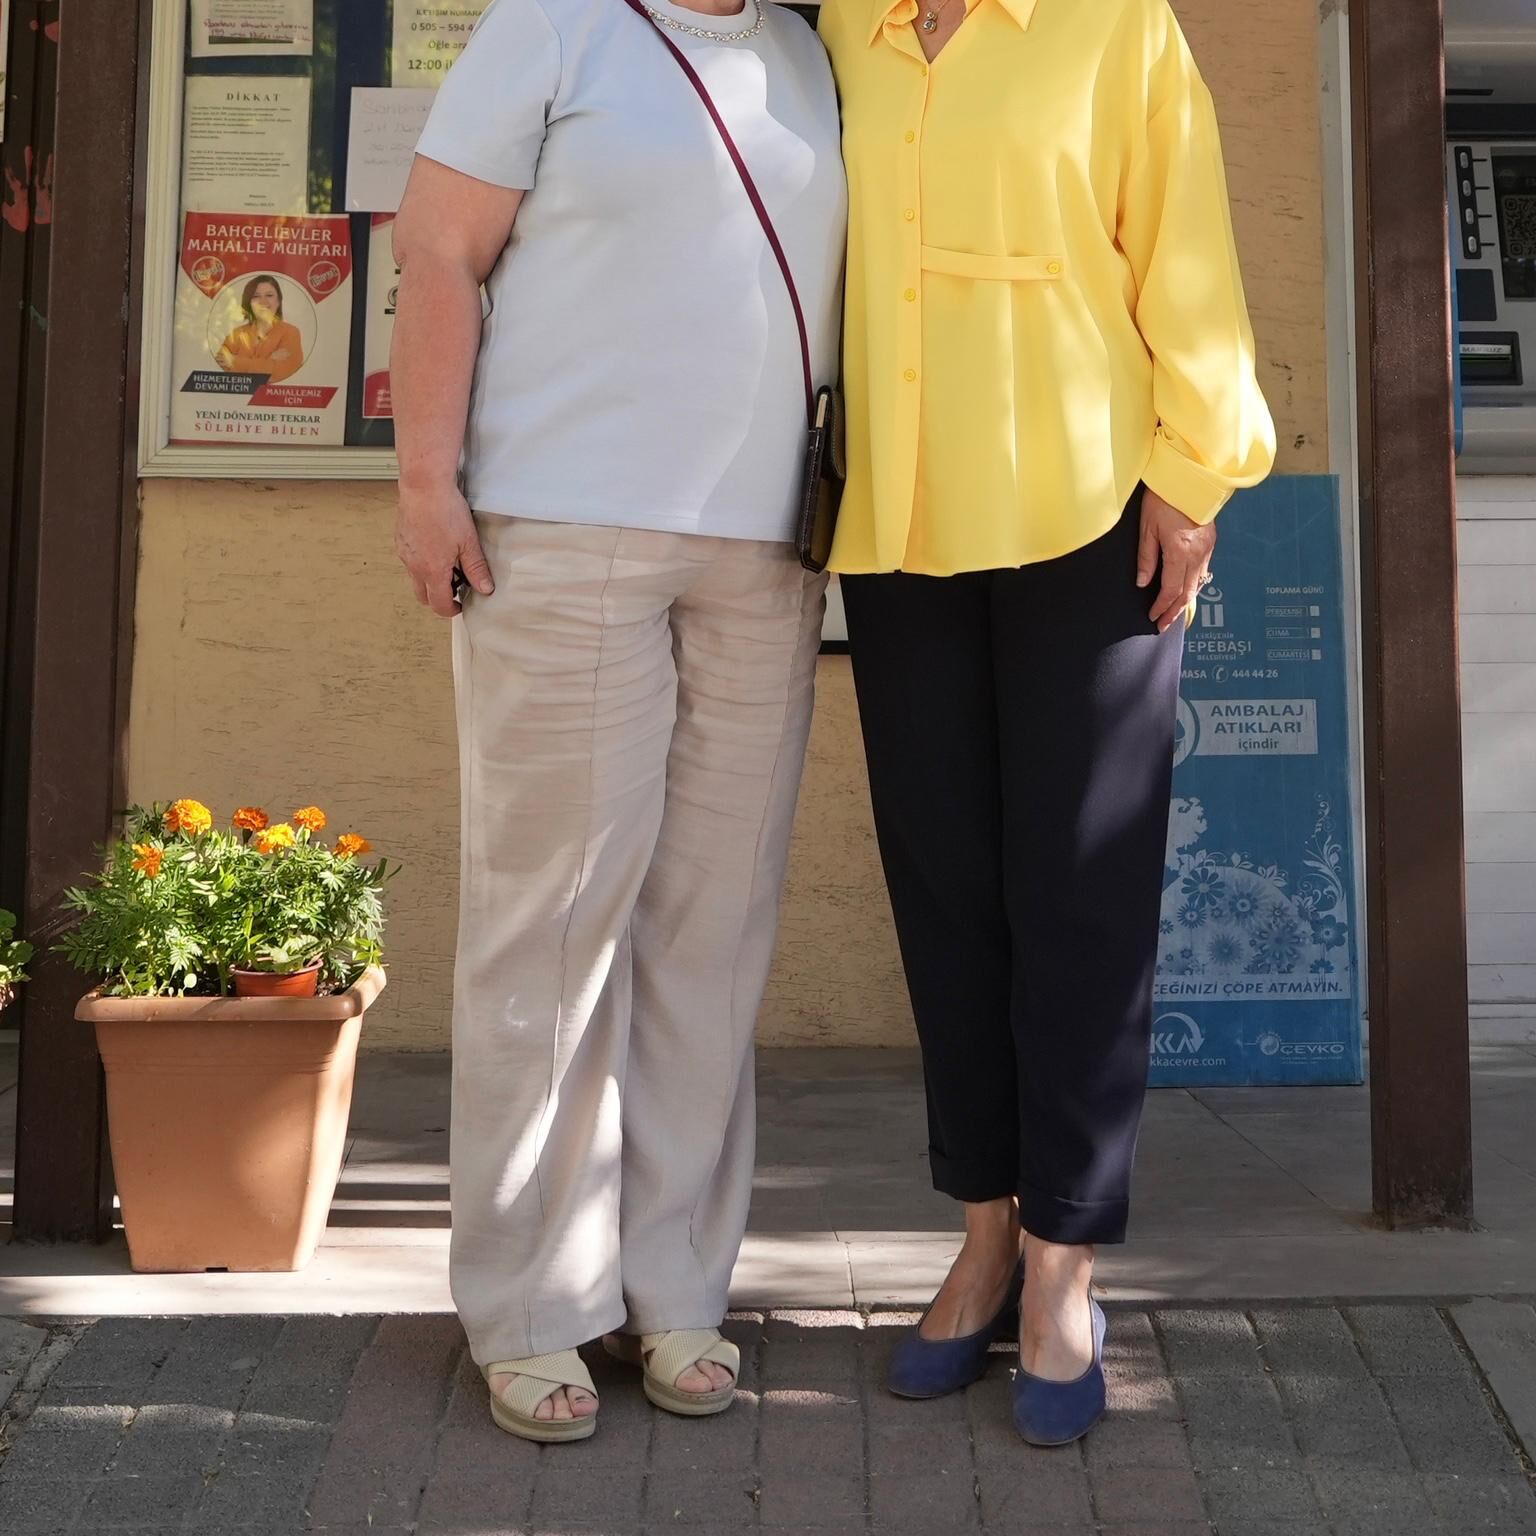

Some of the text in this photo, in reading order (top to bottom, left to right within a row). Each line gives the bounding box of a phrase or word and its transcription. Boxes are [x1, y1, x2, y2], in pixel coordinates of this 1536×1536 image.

[419, 23, 438, 32] 505
[407, 59, 443, 71] 12:00
[206, 224, 332, 242] BAHÇELİEVLER
[187, 238, 348, 257] MAHALLE MUHTARI
[195, 408, 321, 424] YENİ DÖNEMDE TEKRAR
[271, 425, 320, 436] BİLEN
[1265, 586, 1301, 594] TOPLAMA
[1184, 640, 1252, 656] EPEBAŞI
[1232, 669, 1250, 678] 444
[1266, 668, 1278, 678] 26
[1211, 704, 1304, 717] AMBALAJ
[1214, 721, 1302, 734] ATIKLARI
[1238, 737, 1280, 752] içindir
[1223, 980, 1264, 997] ÇÖPE
[1268, 981, 1344, 994] ATMAYIN.
